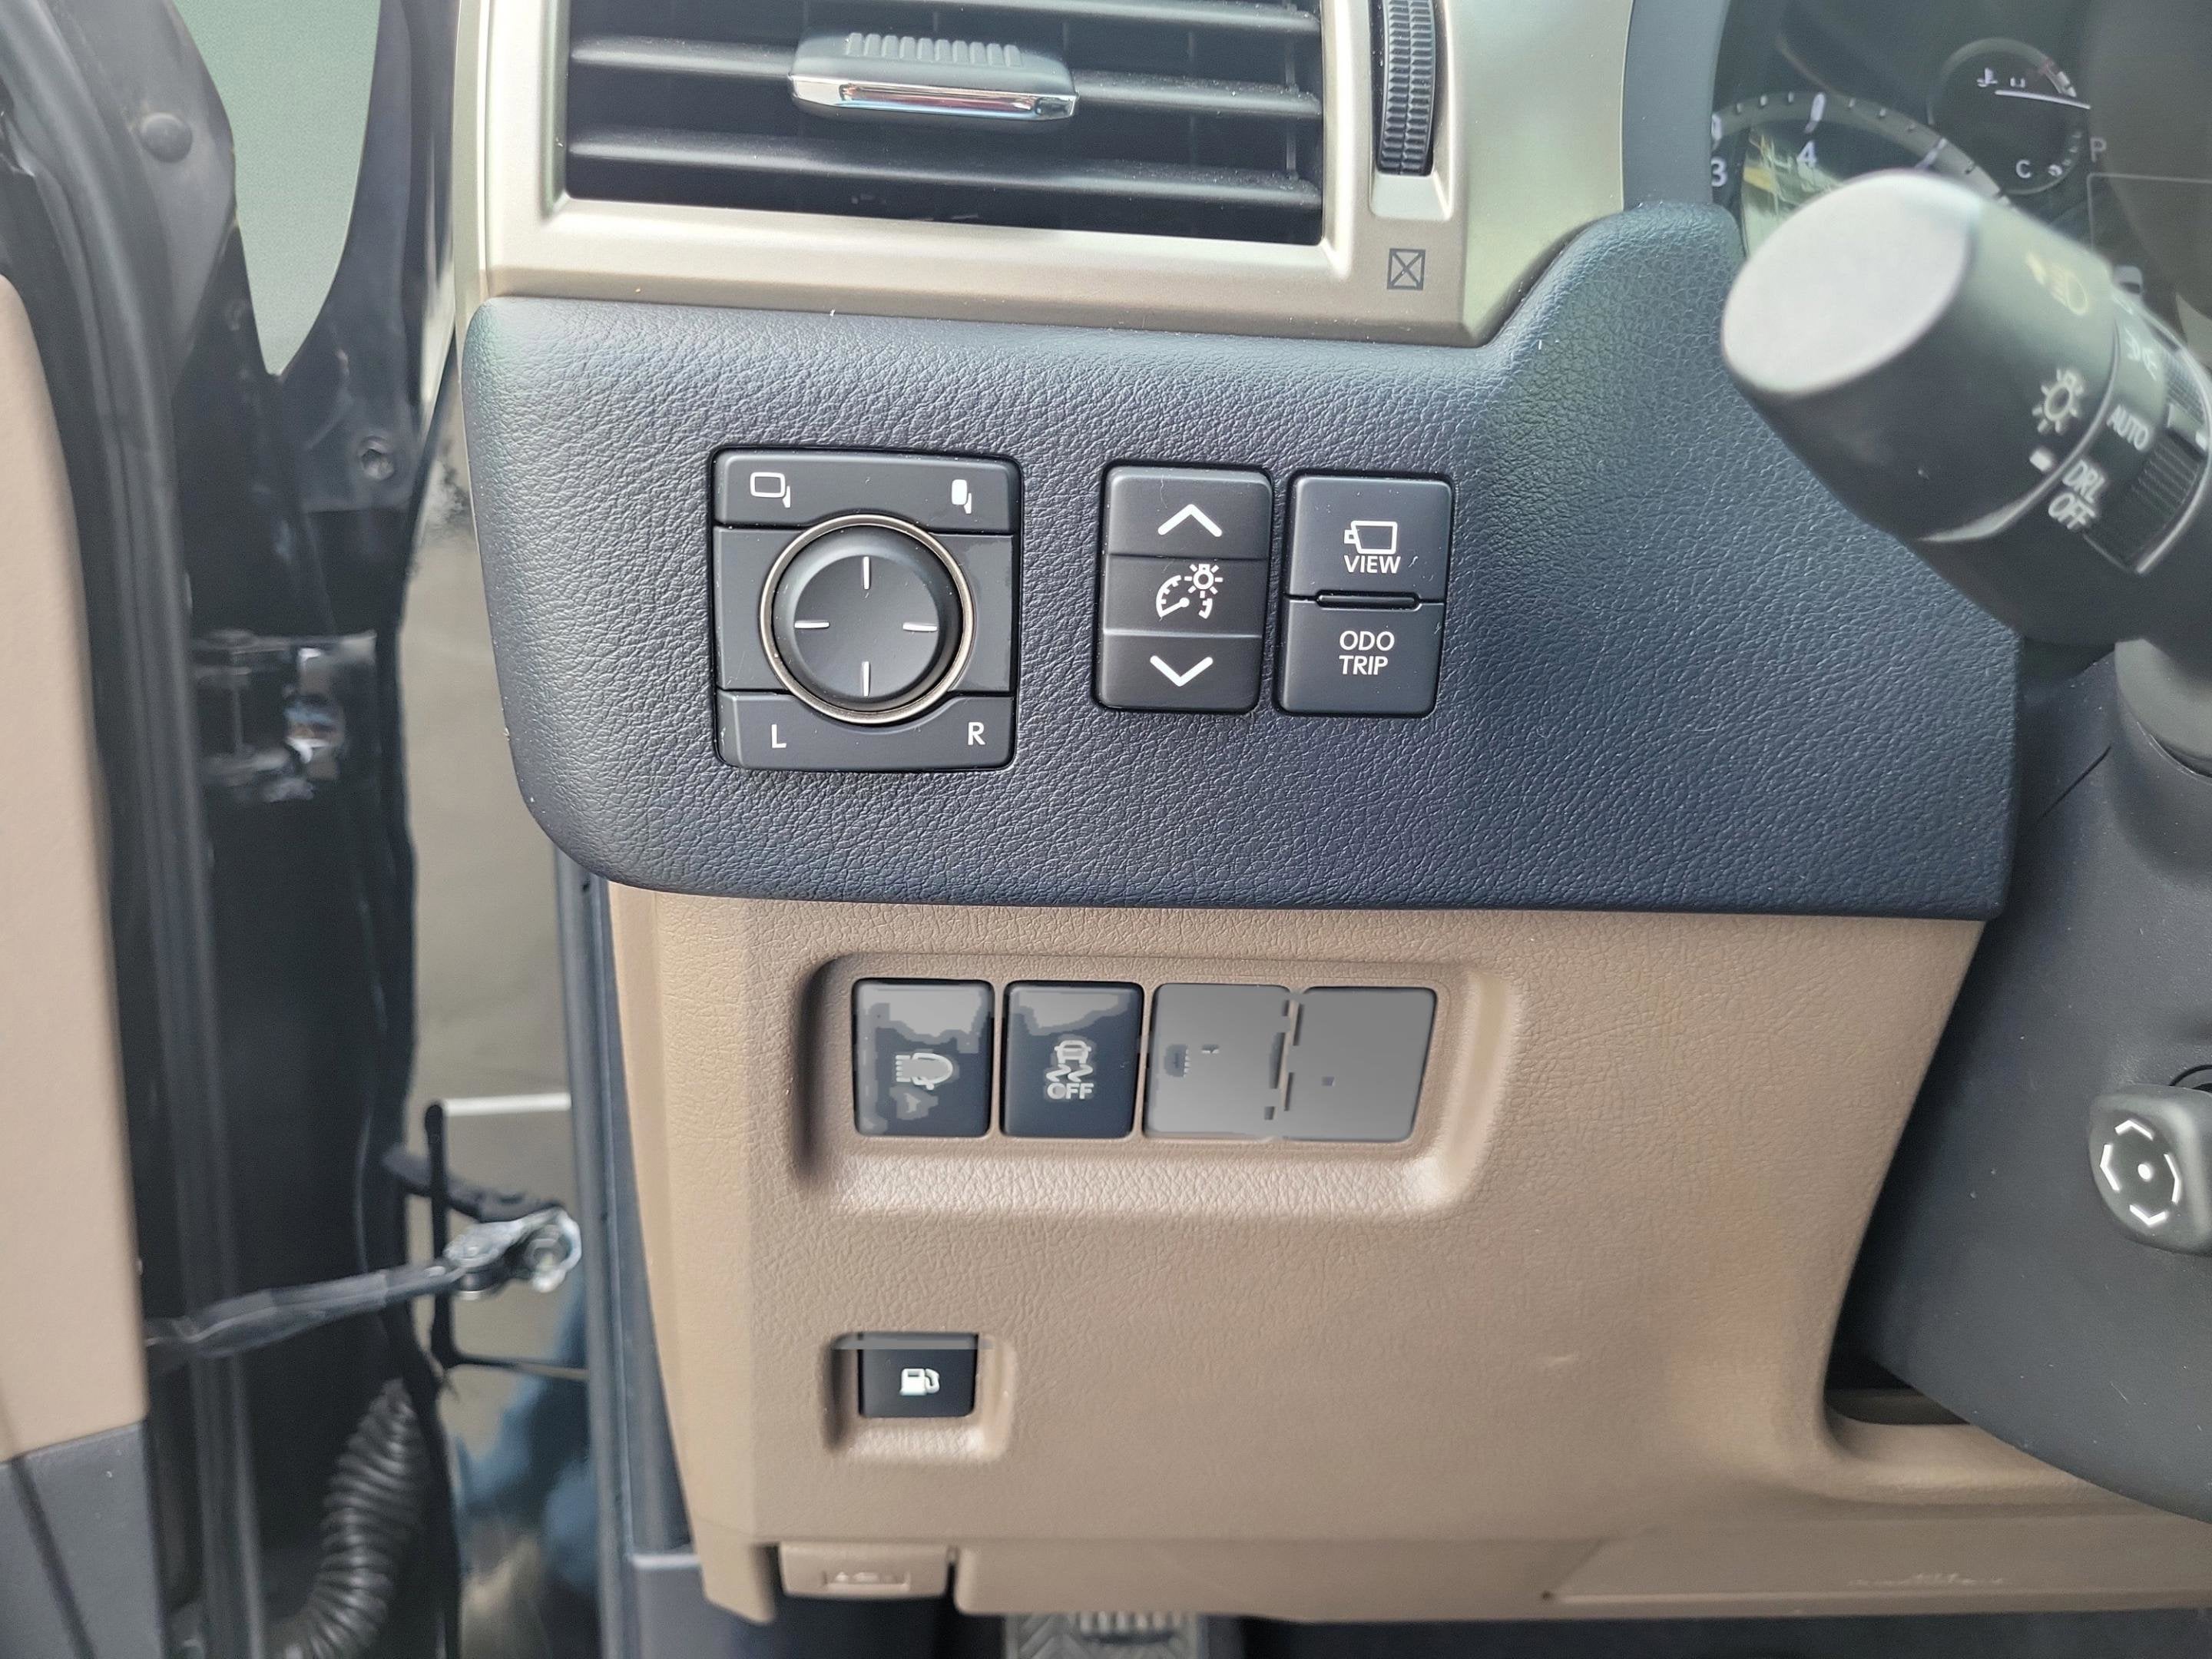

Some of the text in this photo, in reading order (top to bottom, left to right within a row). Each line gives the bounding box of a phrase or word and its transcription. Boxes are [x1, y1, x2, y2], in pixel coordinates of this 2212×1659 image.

[1710, 157, 1728, 187] 3
[2015, 160, 2032, 178] C
[2106, 404, 2150, 450] AUTO
[2062, 459, 2105, 504] DRL
[2048, 492, 2096, 530] OFF
[1343, 555, 1401, 574] VIEW
[1339, 631, 1395, 651] ODO
[1339, 655, 1388, 675] TRIP
[770, 724, 787, 749] L
[966, 721, 985, 747] R
[1047, 1082, 1094, 1100] OFF
